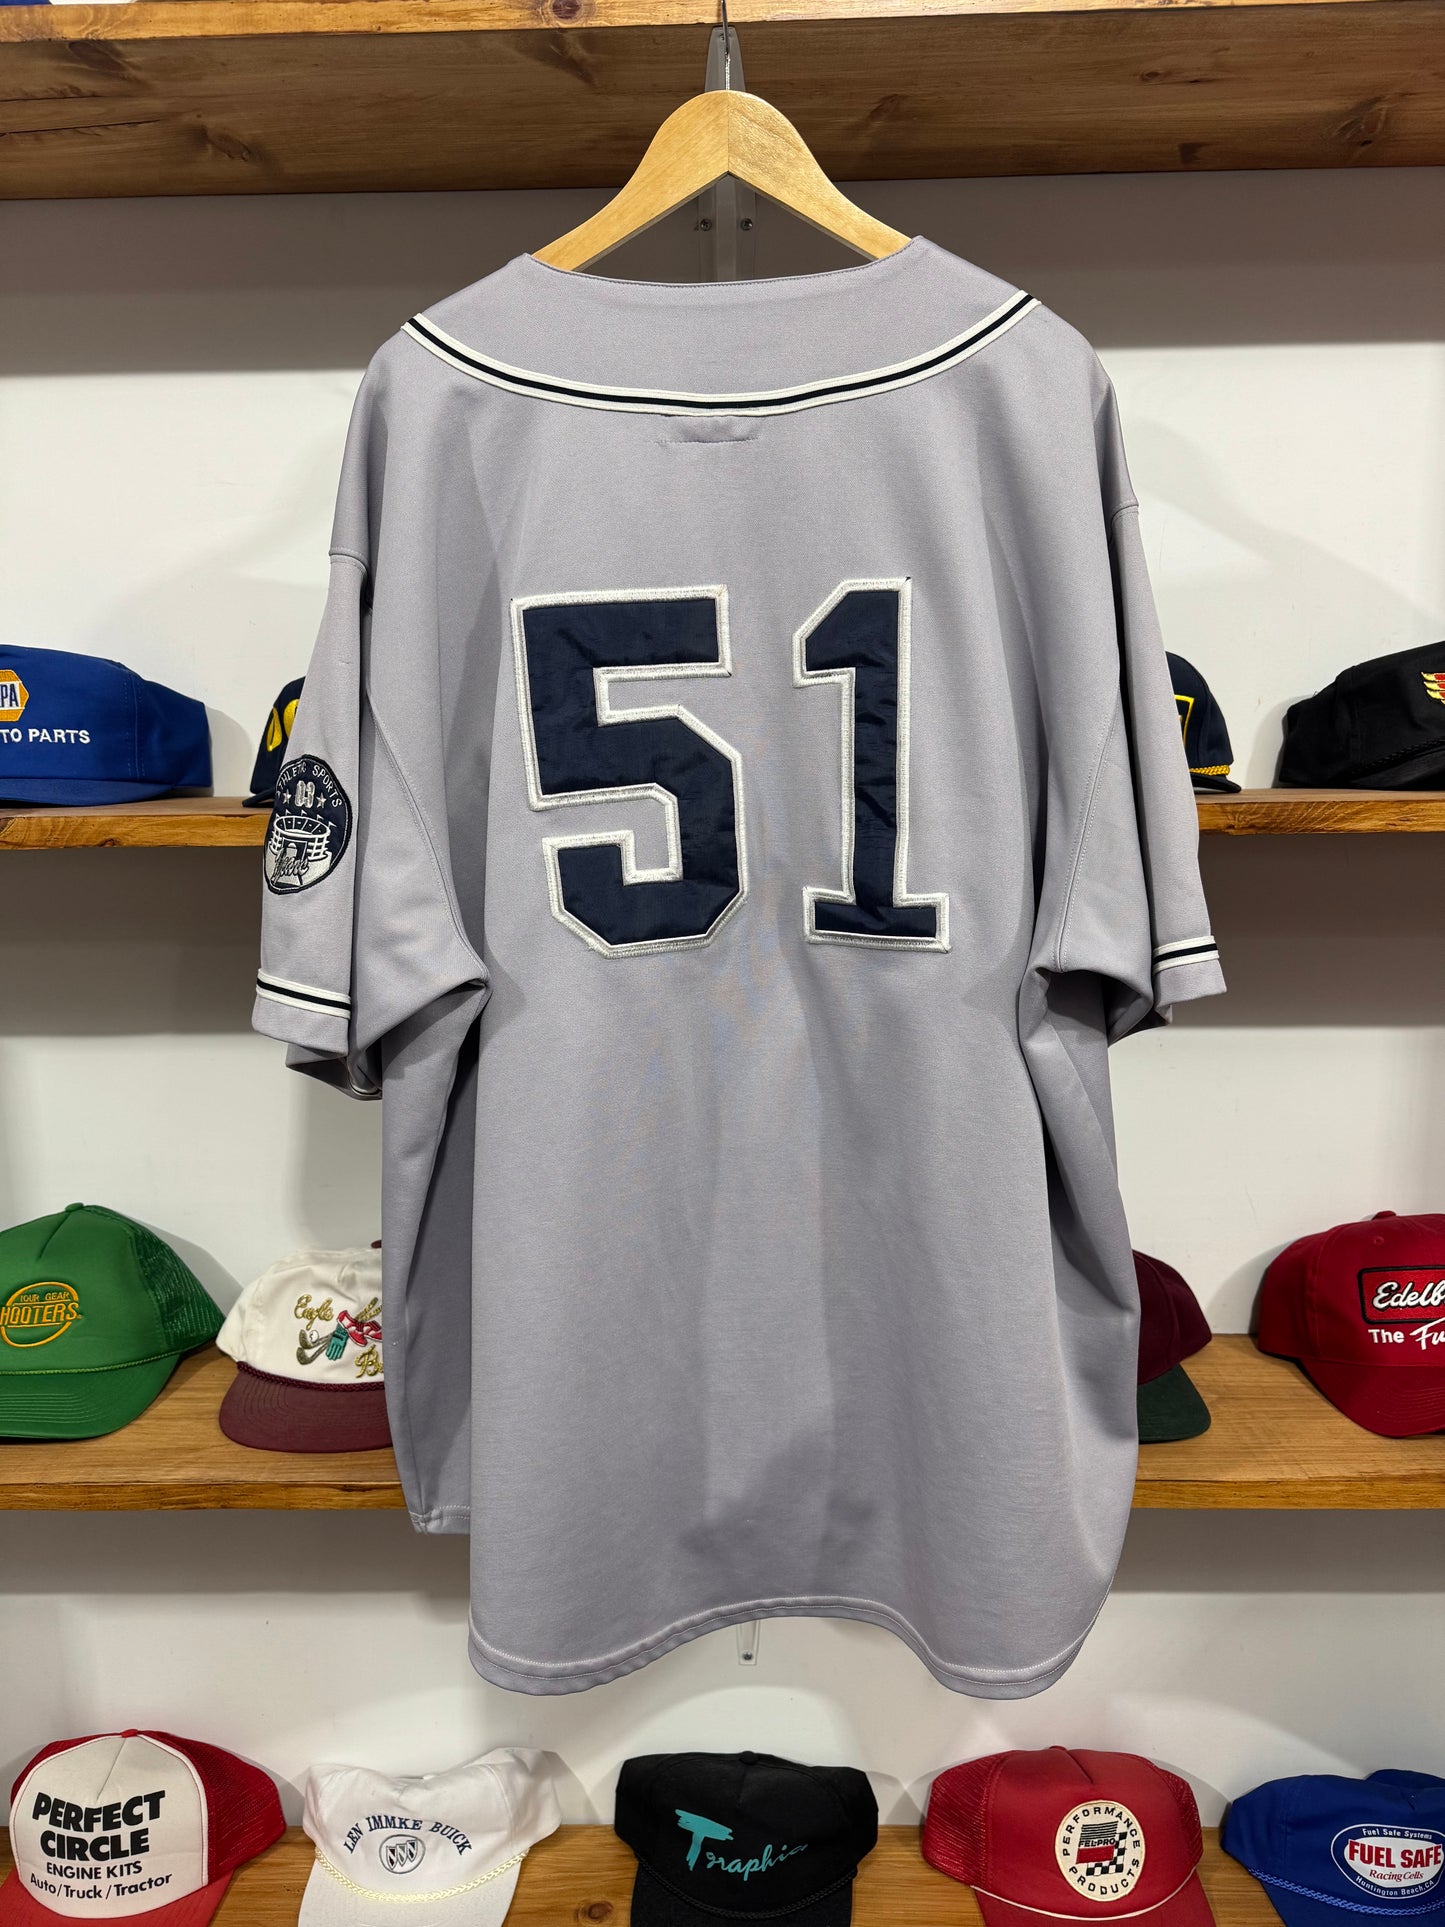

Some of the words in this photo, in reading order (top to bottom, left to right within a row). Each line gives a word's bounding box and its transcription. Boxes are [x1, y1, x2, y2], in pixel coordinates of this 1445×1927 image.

[0, 683, 20, 708] PA
[0, 728, 22, 743] TO
[28, 728, 91, 744] PARTS
[510, 577, 952, 959] 51
[312, 764, 343, 808] SPORTS
[45, 1291, 70, 1301] GEAR
[0, 1302, 79, 1326] HOOTERS
[294, 1294, 334, 1331] Eagle
[1368, 1329, 1405, 1343] The
[1409, 1317, 1445, 1351] Fu
[32, 1790, 166, 1833] PERFECT
[40, 1828, 150, 1862] CIRCLE
[343, 1823, 363, 1854] LEN
[365, 1814, 424, 1832] IMMKE
[428, 1821, 473, 1856] BUICK
[1062, 1806, 1141, 1857] PERFORMANCE
[1362, 1828, 1380, 1836] Fuel
[1383, 1828, 1401, 1837] Safe
[1404, 1830, 1433, 1840] Systems
[1348, 1839, 1396, 1869] FUEL
[1400, 1844, 1442, 1869] SAFE
[46, 1862, 102, 1880] ENGINE
[106, 1861, 143, 1878] KITS
[1068, 1857, 1140, 1895] PRODUCTS
[1355, 1875, 1398, 1896] Huntington
[1369, 1869, 1402, 1882] Racing
[1403, 1871, 1424, 1880] Cells
